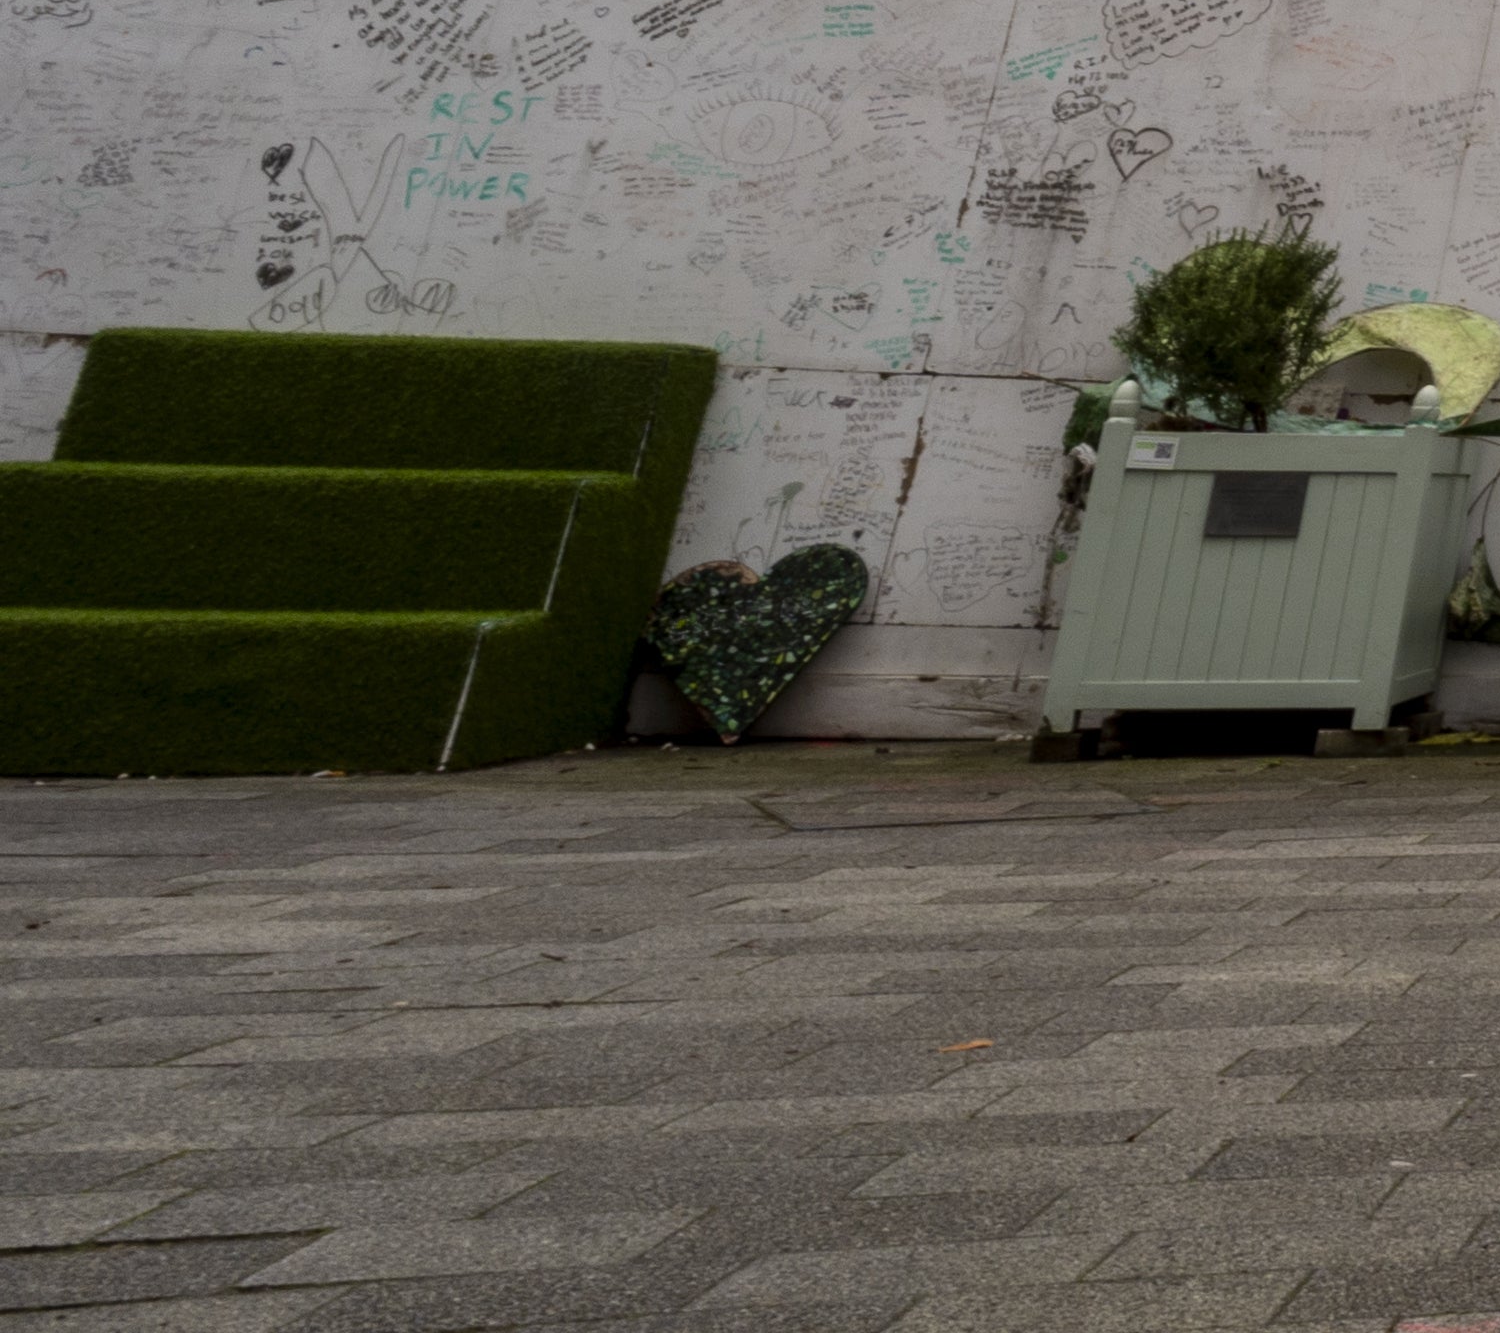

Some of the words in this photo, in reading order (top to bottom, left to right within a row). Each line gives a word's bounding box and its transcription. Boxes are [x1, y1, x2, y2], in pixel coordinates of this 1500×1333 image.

[430, 91, 547, 125] REST
[425, 134, 495, 163] IN
[404, 168, 532, 210] POWER
